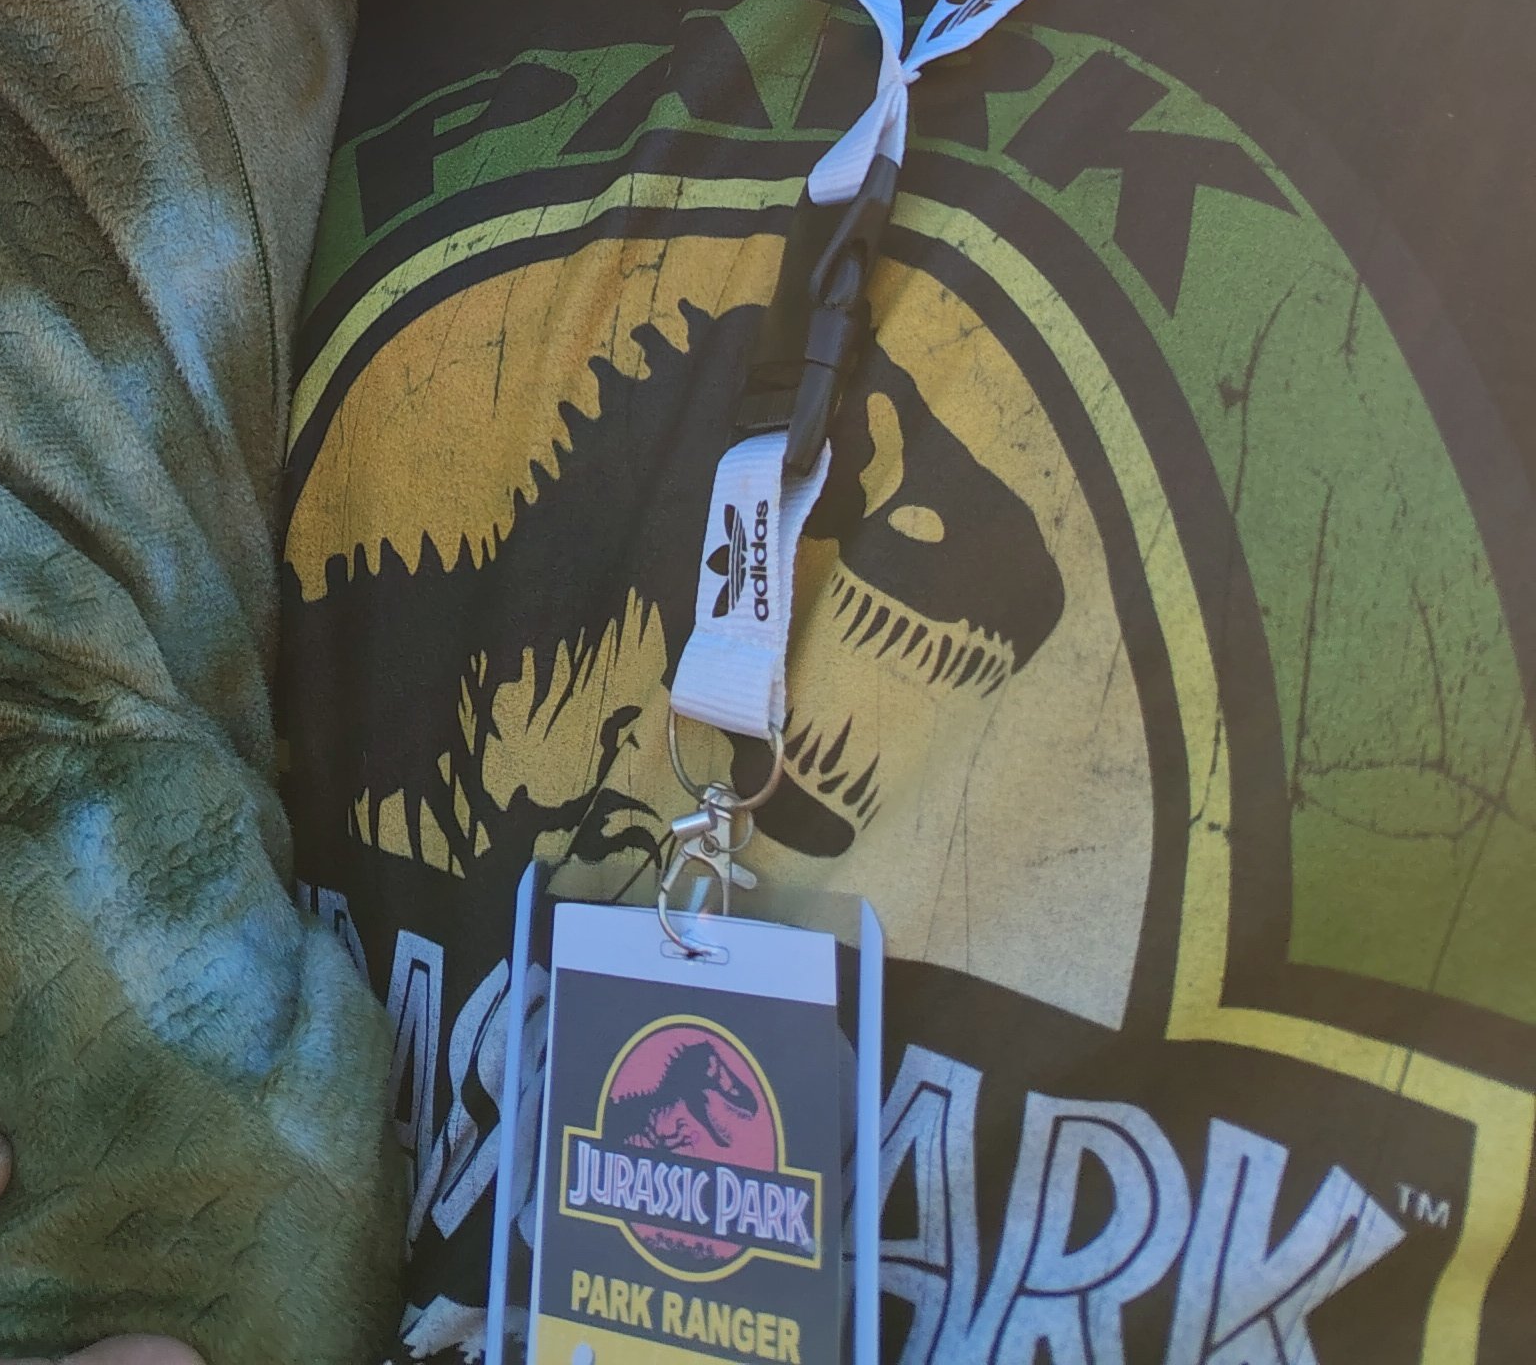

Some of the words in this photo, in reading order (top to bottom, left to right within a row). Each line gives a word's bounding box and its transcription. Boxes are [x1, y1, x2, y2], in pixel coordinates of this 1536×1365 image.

[750, 499, 769, 622] adidas
[568, 1139, 711, 1226] JURASSIC
[714, 1166, 811, 1246] PARK
[842, 1042, 1407, 1365] ARK
[570, 1269, 655, 1329] PARK
[661, 1290, 802, 1365] RANGER
